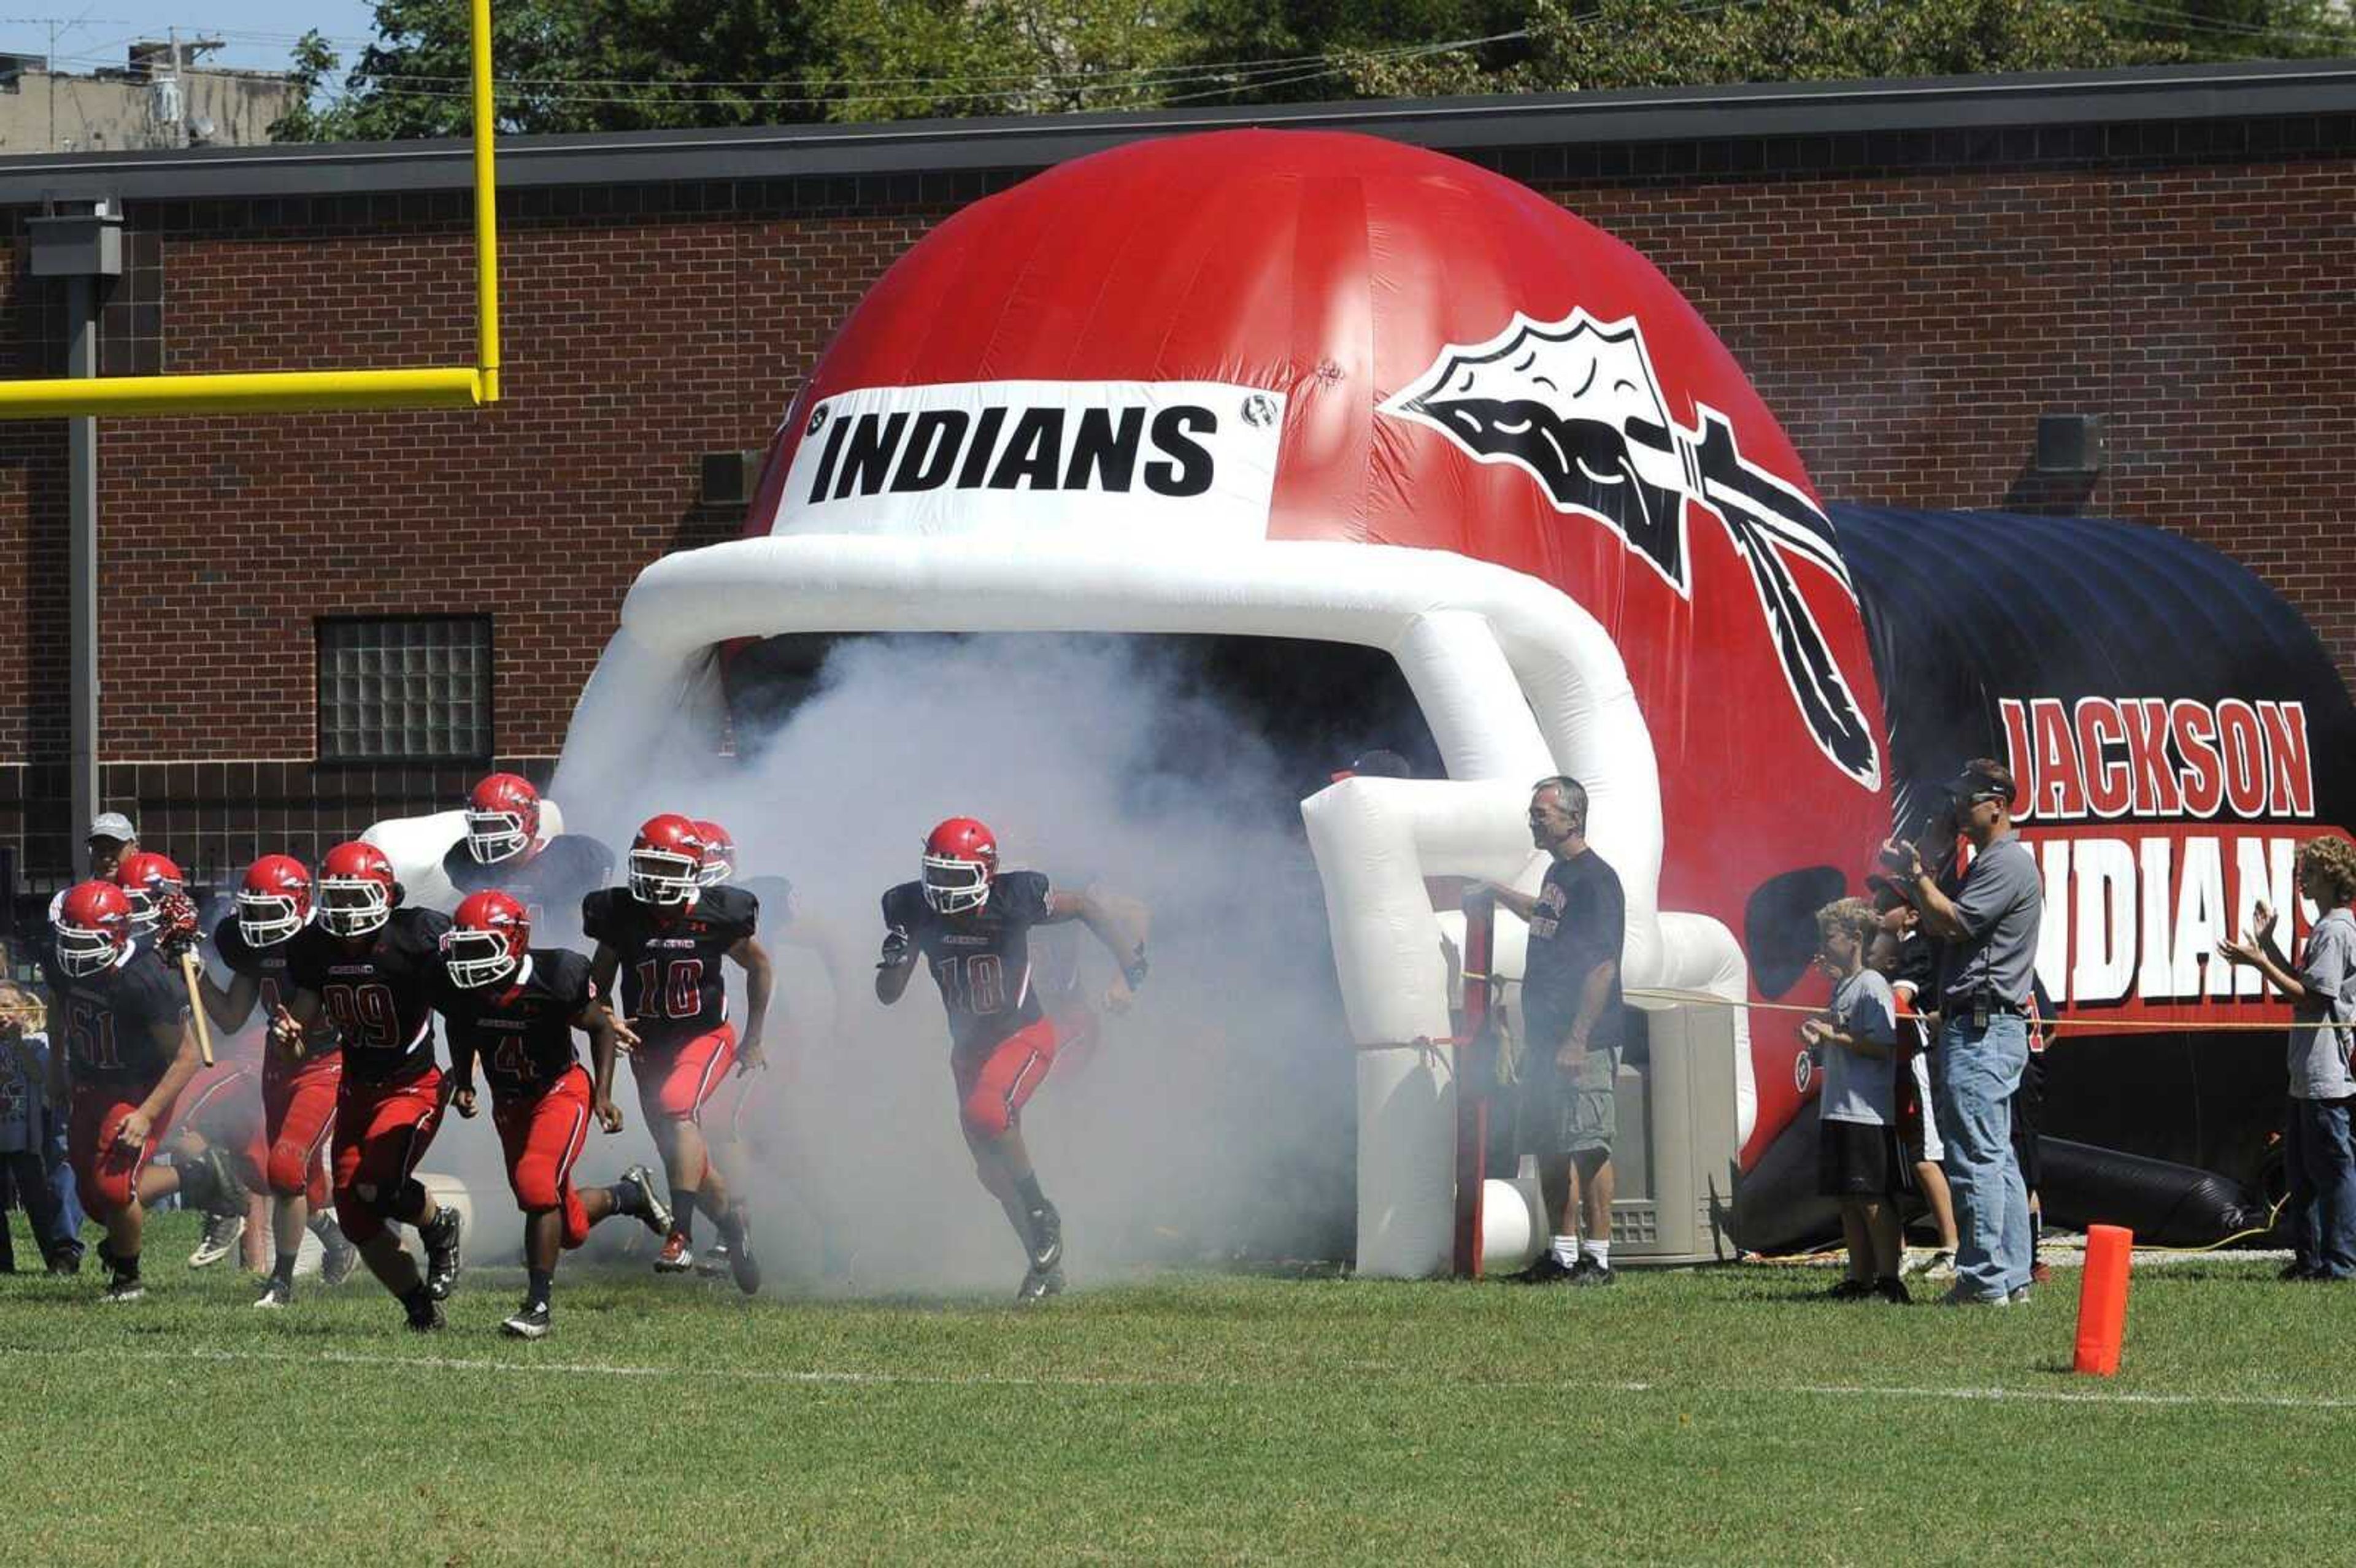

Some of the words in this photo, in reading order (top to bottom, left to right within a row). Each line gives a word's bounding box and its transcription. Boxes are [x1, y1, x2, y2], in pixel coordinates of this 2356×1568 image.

[808, 405, 1217, 504] INDIANS
[1998, 697, 2315, 821] JACKSON
[1965, 836, 2323, 1002] NDIAN
[636, 958, 704, 1018] 10
